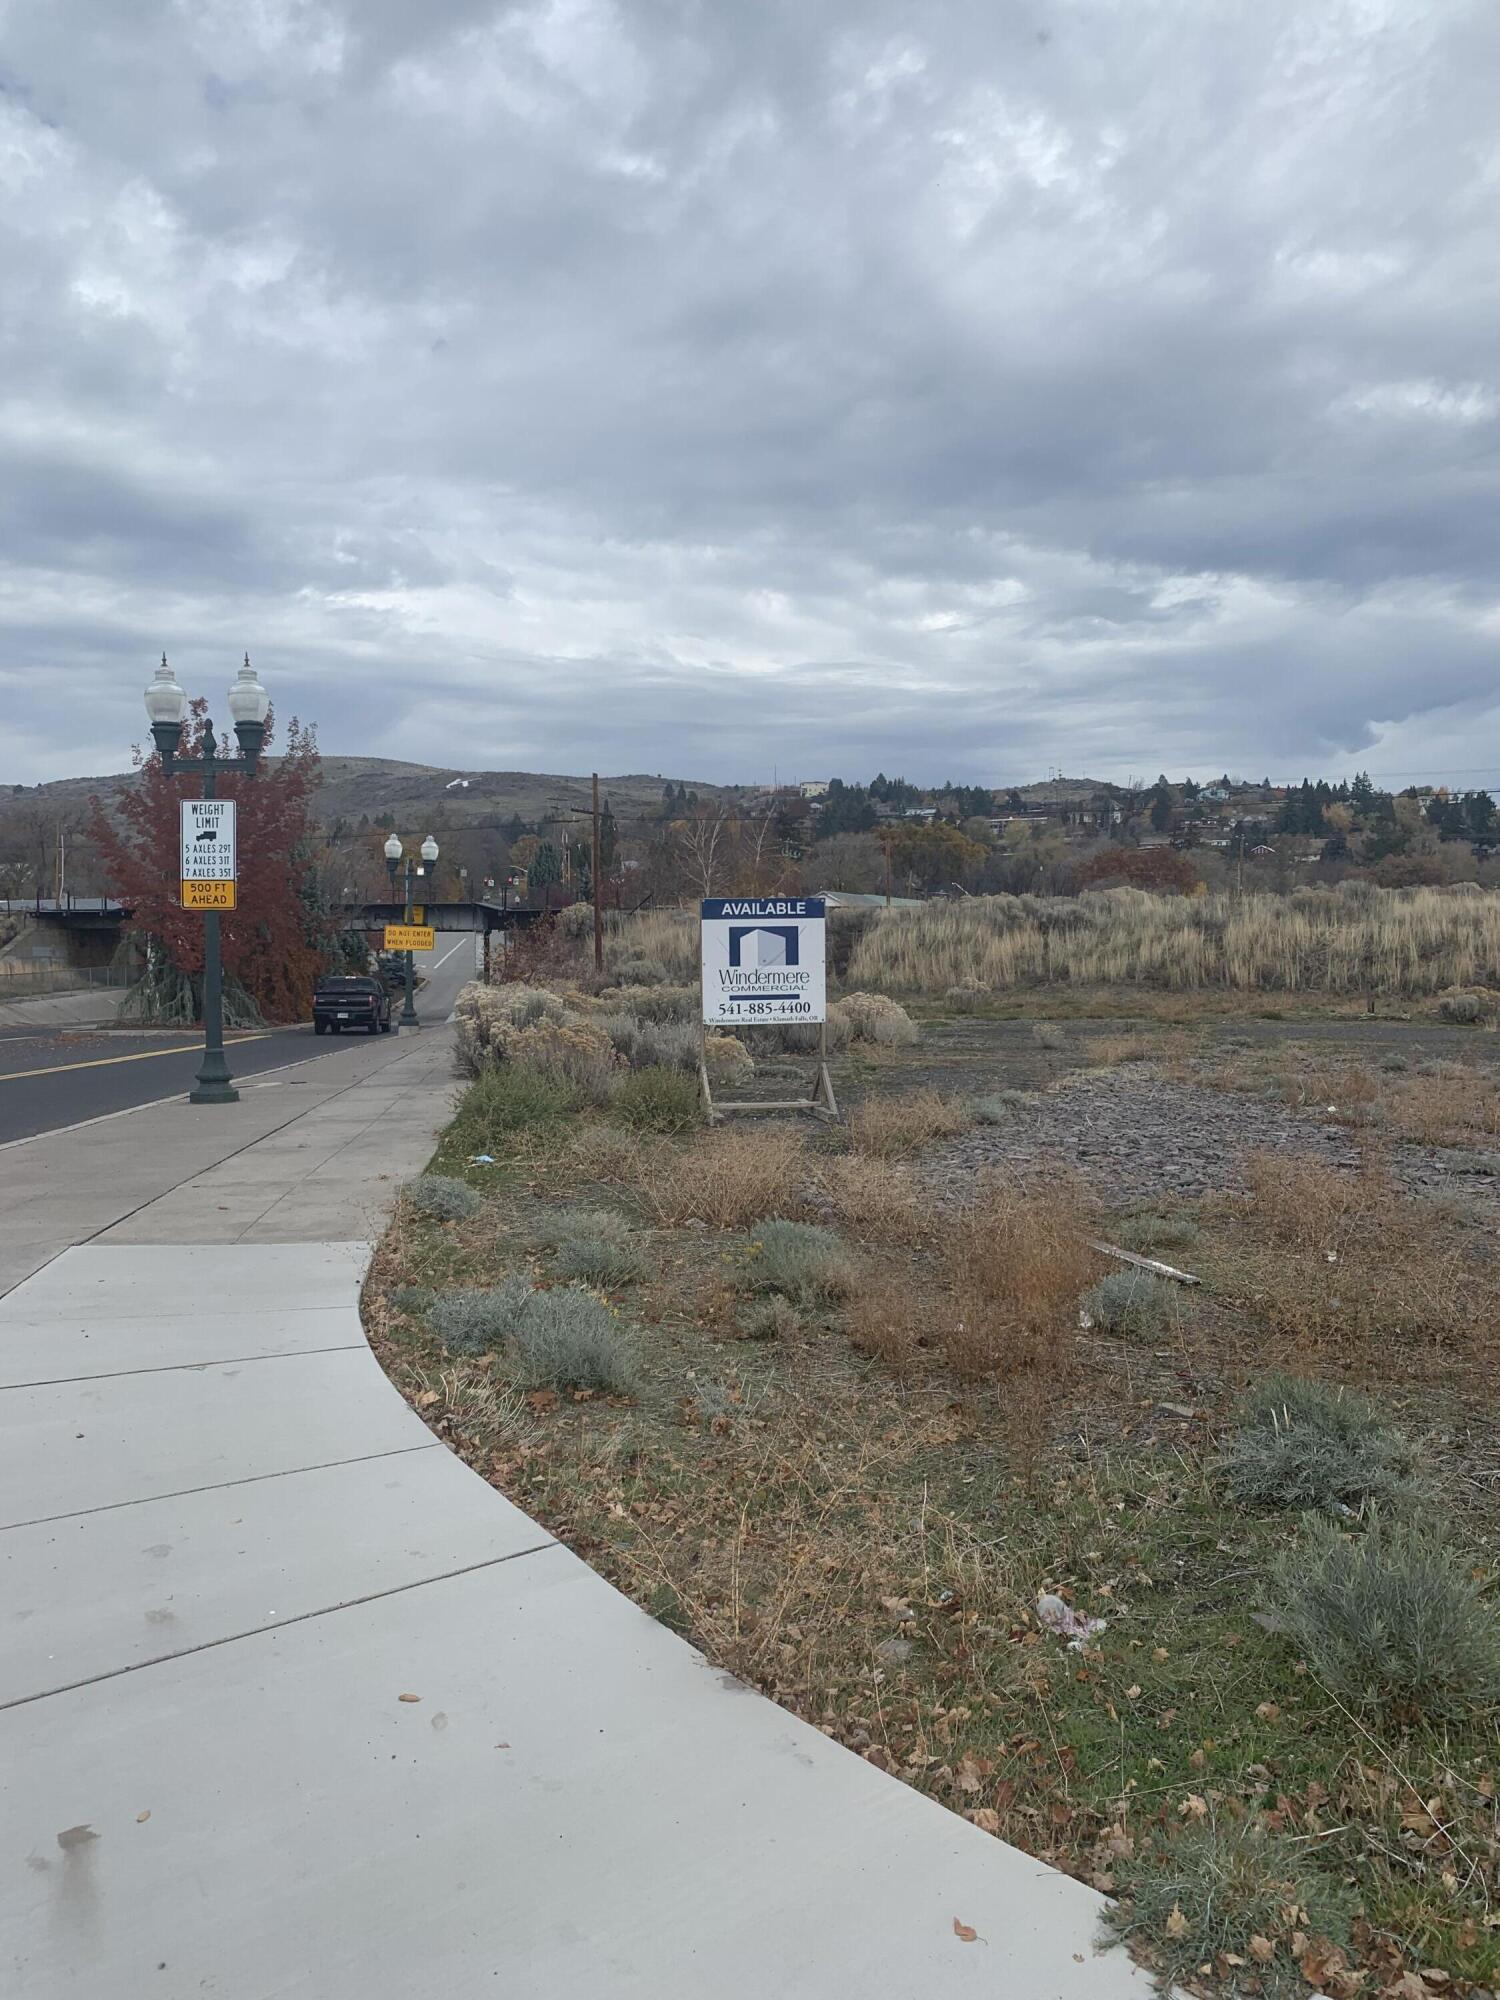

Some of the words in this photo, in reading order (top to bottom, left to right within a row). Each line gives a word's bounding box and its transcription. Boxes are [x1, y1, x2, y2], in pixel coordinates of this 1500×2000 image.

[192, 804, 224, 815] WEIGHT
[196, 817, 219, 828] LIMIT
[185, 844, 190, 853] 5
[193, 844, 216, 853] AXLES
[219, 844, 231, 853] 29T
[185, 856, 190, 865] 6
[193, 856, 216, 865] AXLES
[219, 856, 230, 865] 31T
[185, 868, 190, 877] 7
[192, 868, 216, 877] AXLES
[219, 868, 231, 877] 35T
[190, 884, 211, 892] 500
[215, 884, 226, 892] FT
[191, 895, 227, 904] AHEAD
[721, 902, 806, 915] AVAILABLE
[719, 969, 810, 985] Windermere
[719, 1001, 811, 1016] 541-885-4400
